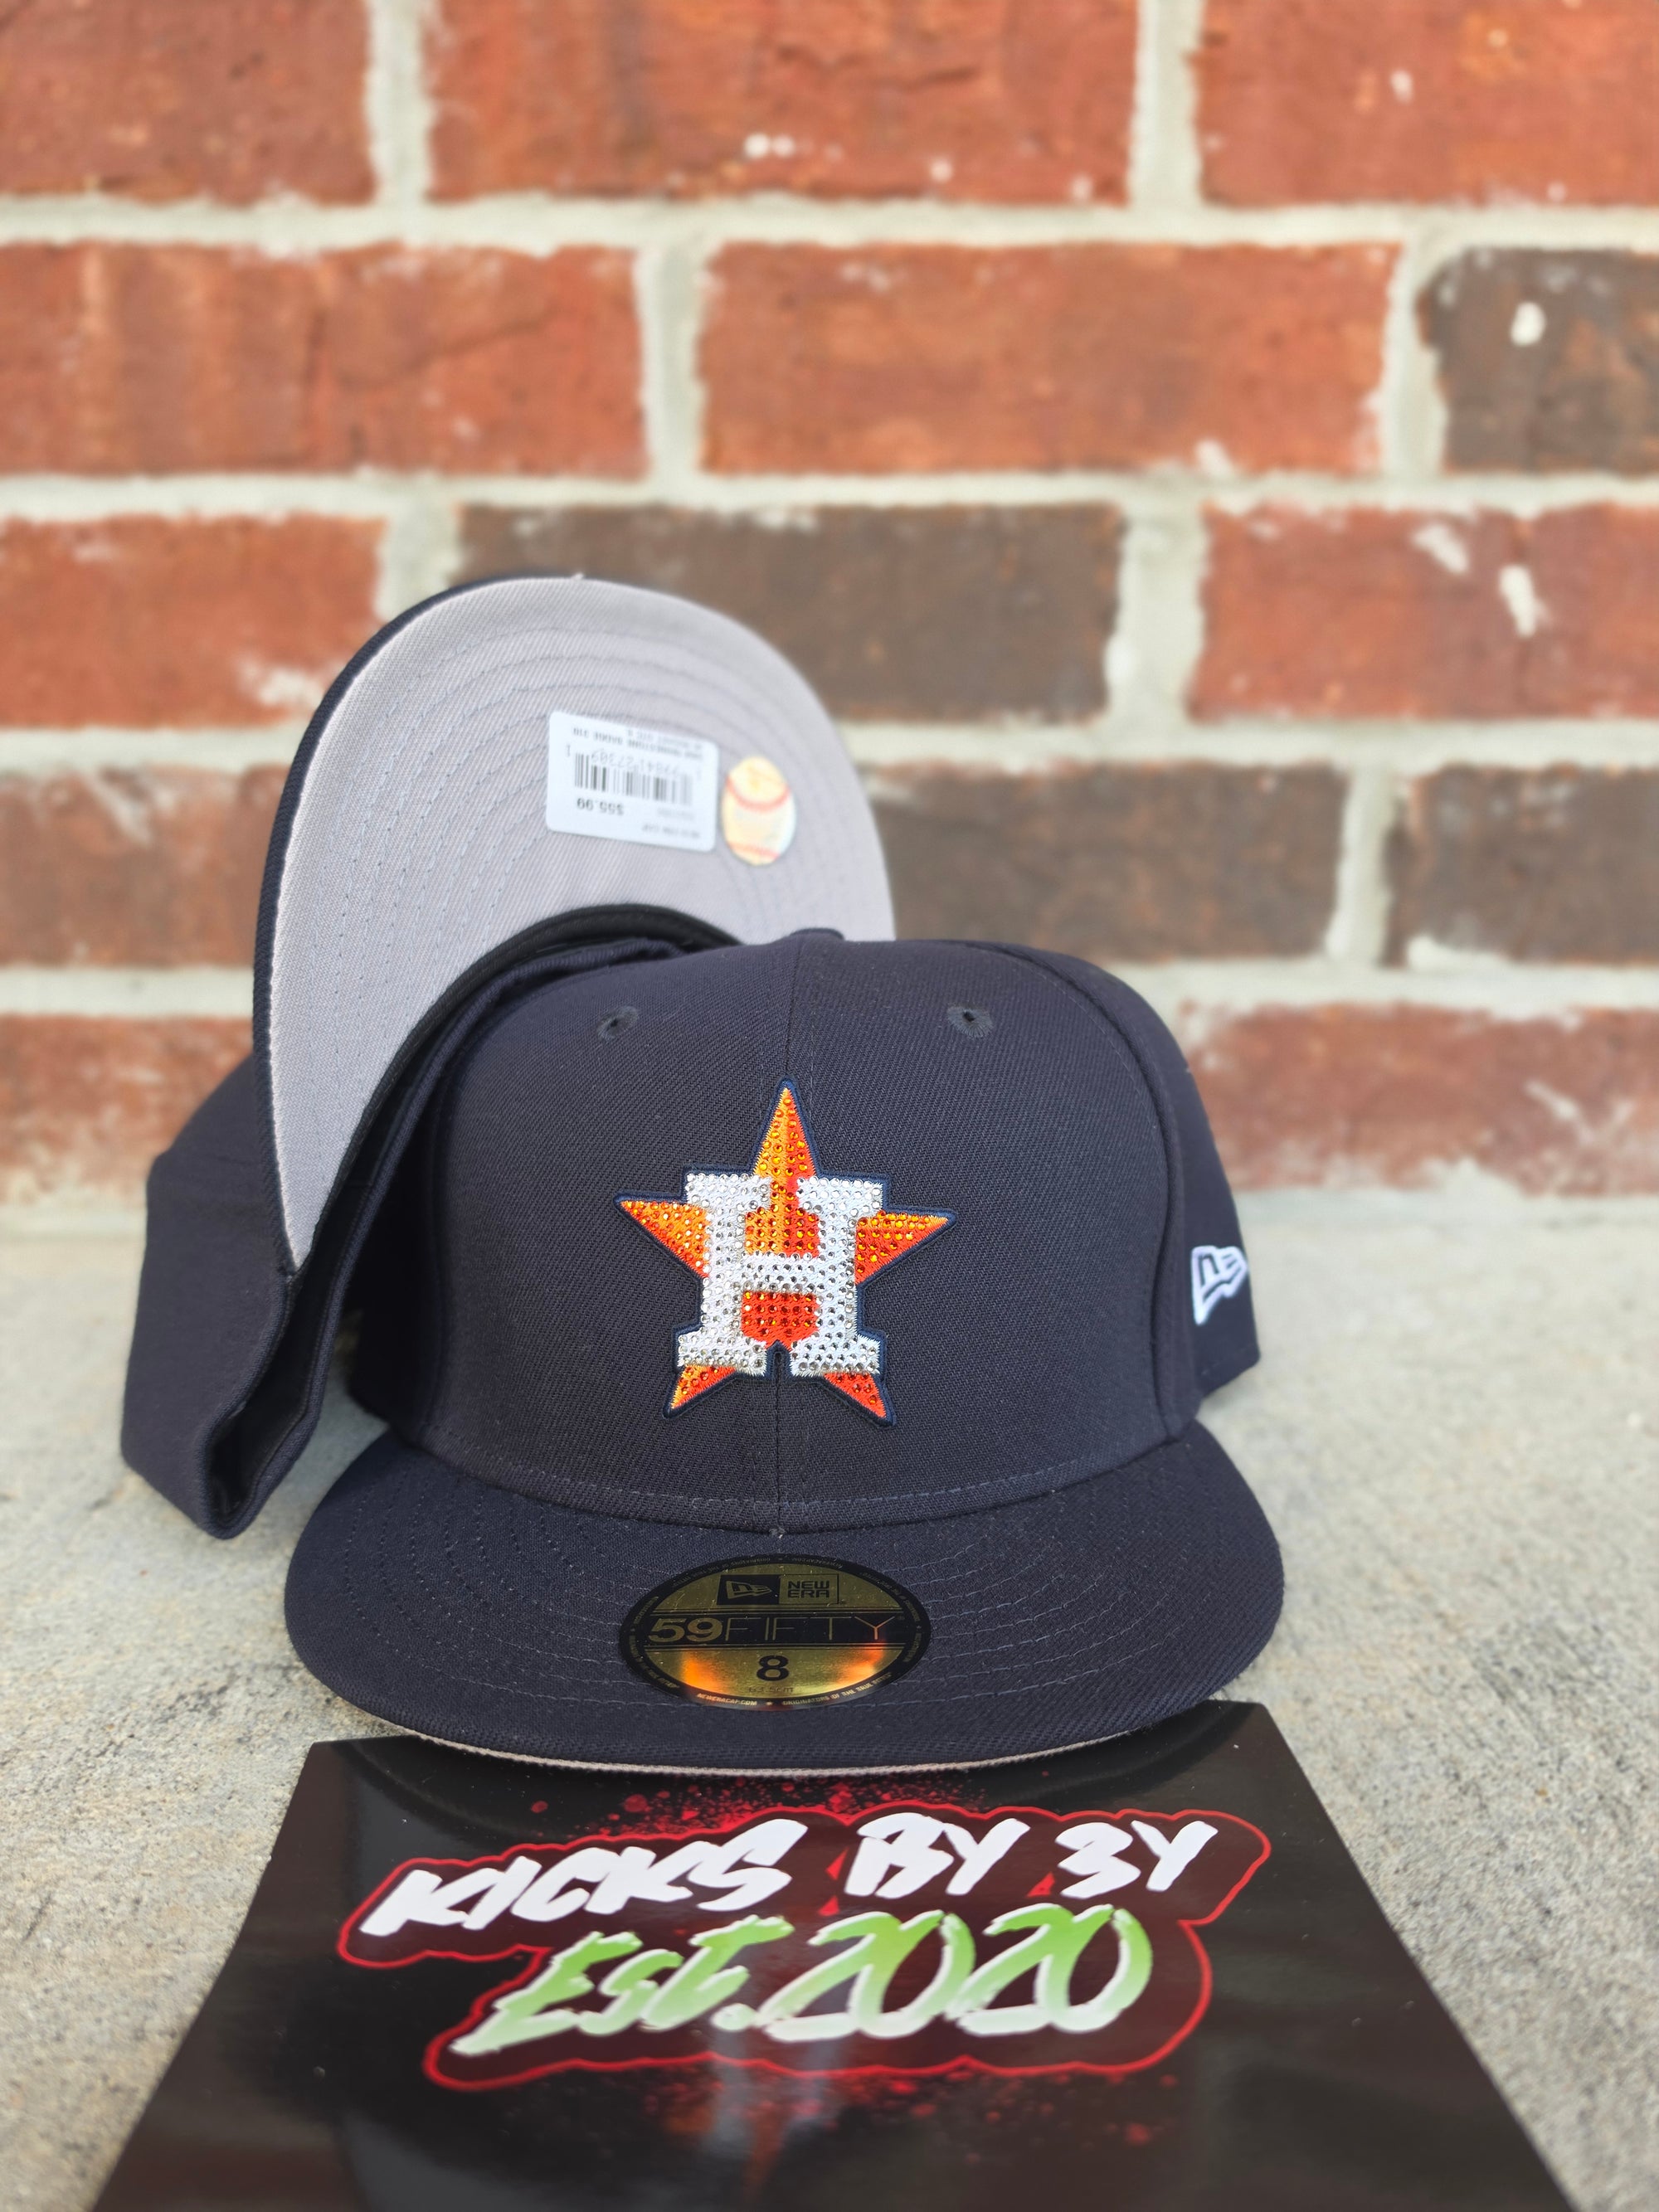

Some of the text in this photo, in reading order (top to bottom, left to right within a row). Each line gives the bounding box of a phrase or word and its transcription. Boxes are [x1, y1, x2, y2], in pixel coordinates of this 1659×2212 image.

[577, 798, 624, 816] $55.99
[787, 1580, 830, 1589] NEW
[787, 1588, 830, 1598] ERA
[647, 1616, 896, 1643] 59FIFTY
[756, 1655, 790, 1682] 8
[360, 1812, 1218, 1936] KICKS BY 3Y
